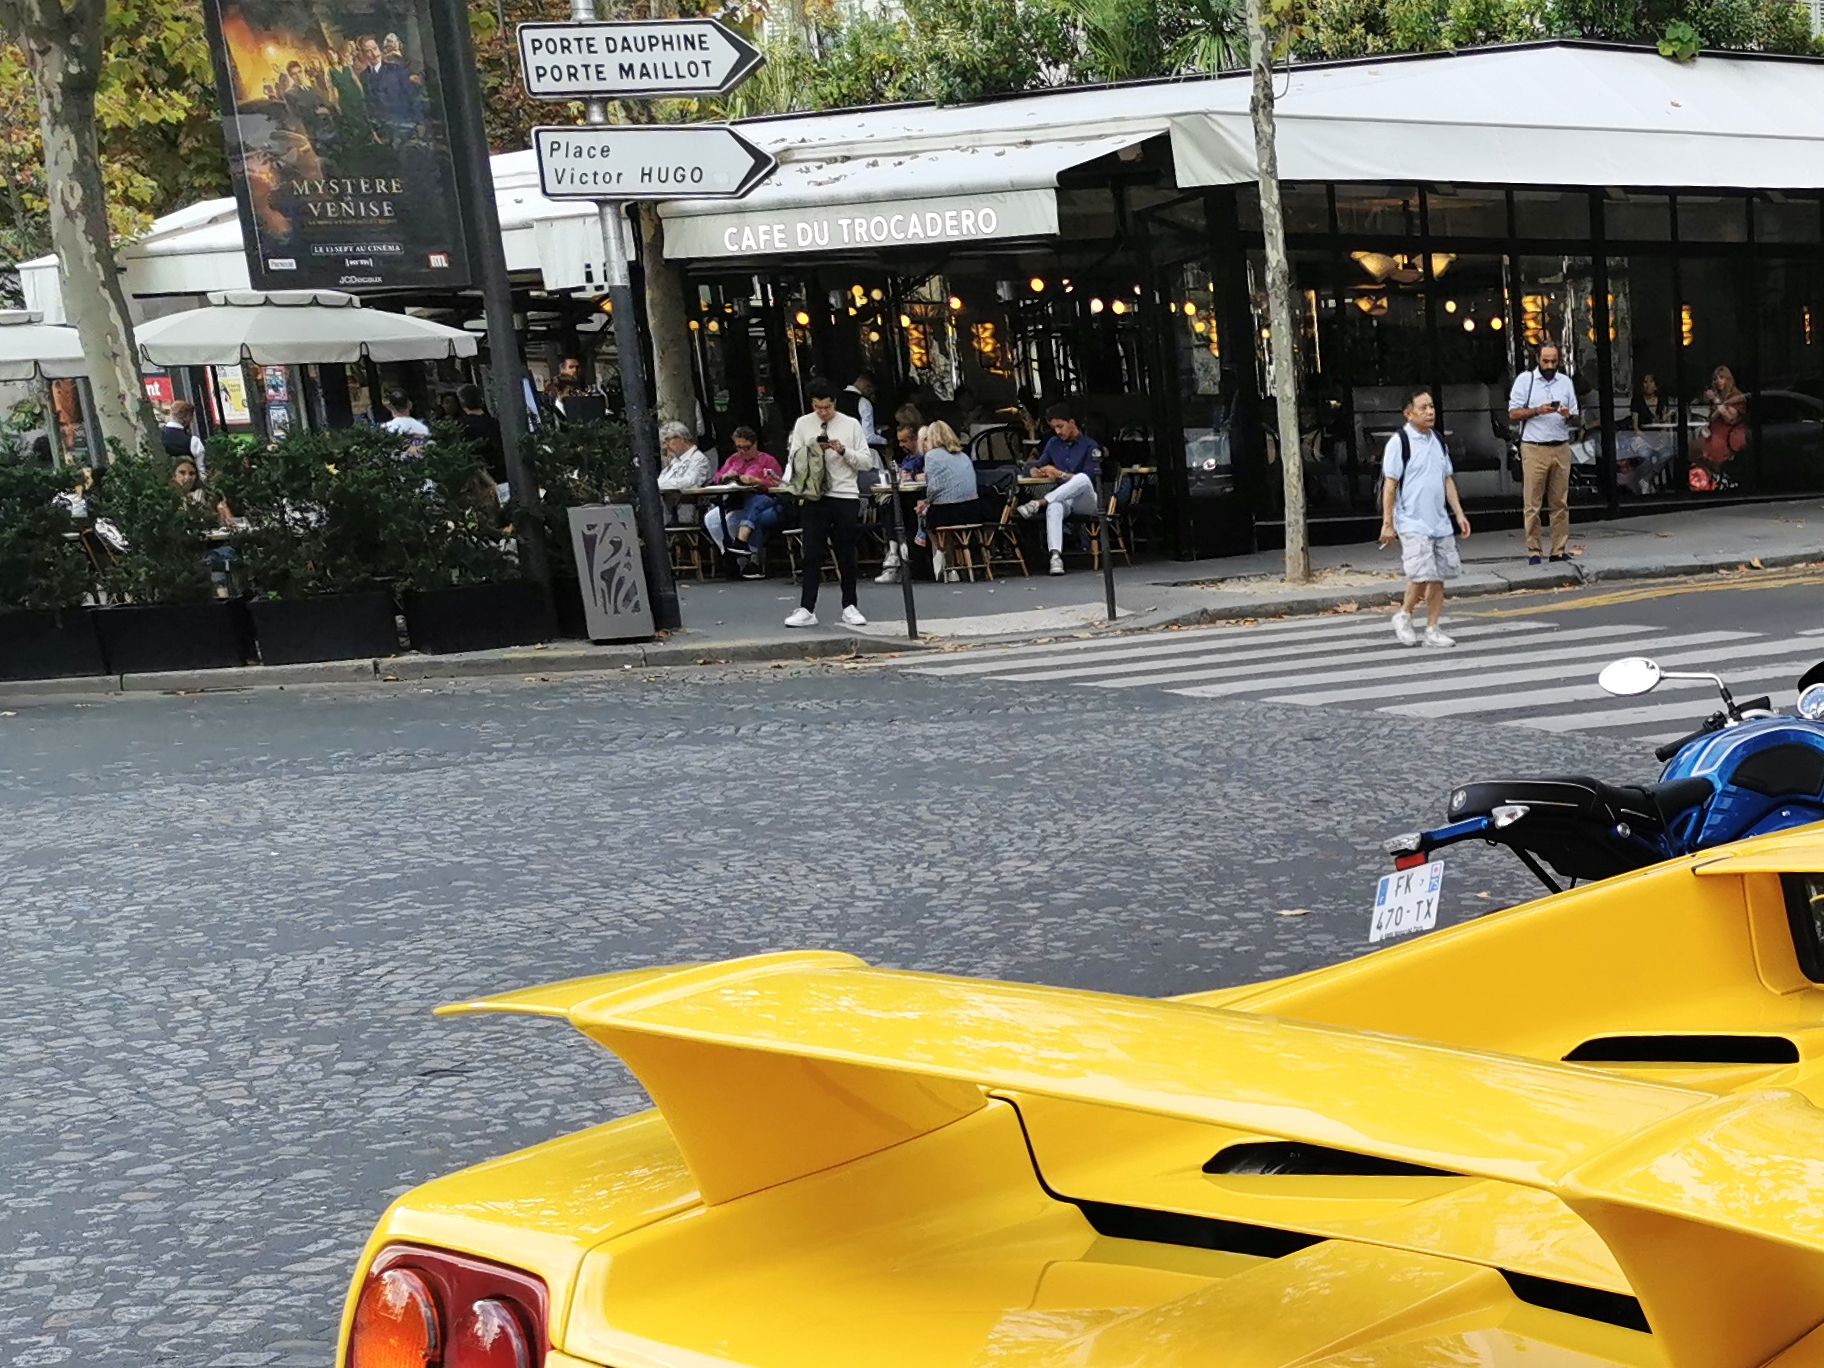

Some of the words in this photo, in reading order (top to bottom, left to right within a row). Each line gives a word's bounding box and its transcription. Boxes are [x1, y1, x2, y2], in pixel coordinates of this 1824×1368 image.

[531, 37, 598, 56] PORTE
[606, 34, 710, 54] DAUPHINE
[535, 64, 606, 83] PORTE
[619, 60, 712, 80] MAILLOT
[549, 141, 611, 158] Place
[554, 168, 623, 185] Victor
[640, 166, 703, 184] HUGO
[308, 201, 396, 218] VENISE
[724, 224, 788, 251] CAFE
[796, 220, 829, 246] DU
[838, 207, 998, 243] TROCADERO
[339, 275, 383, 284] JCDecaux
